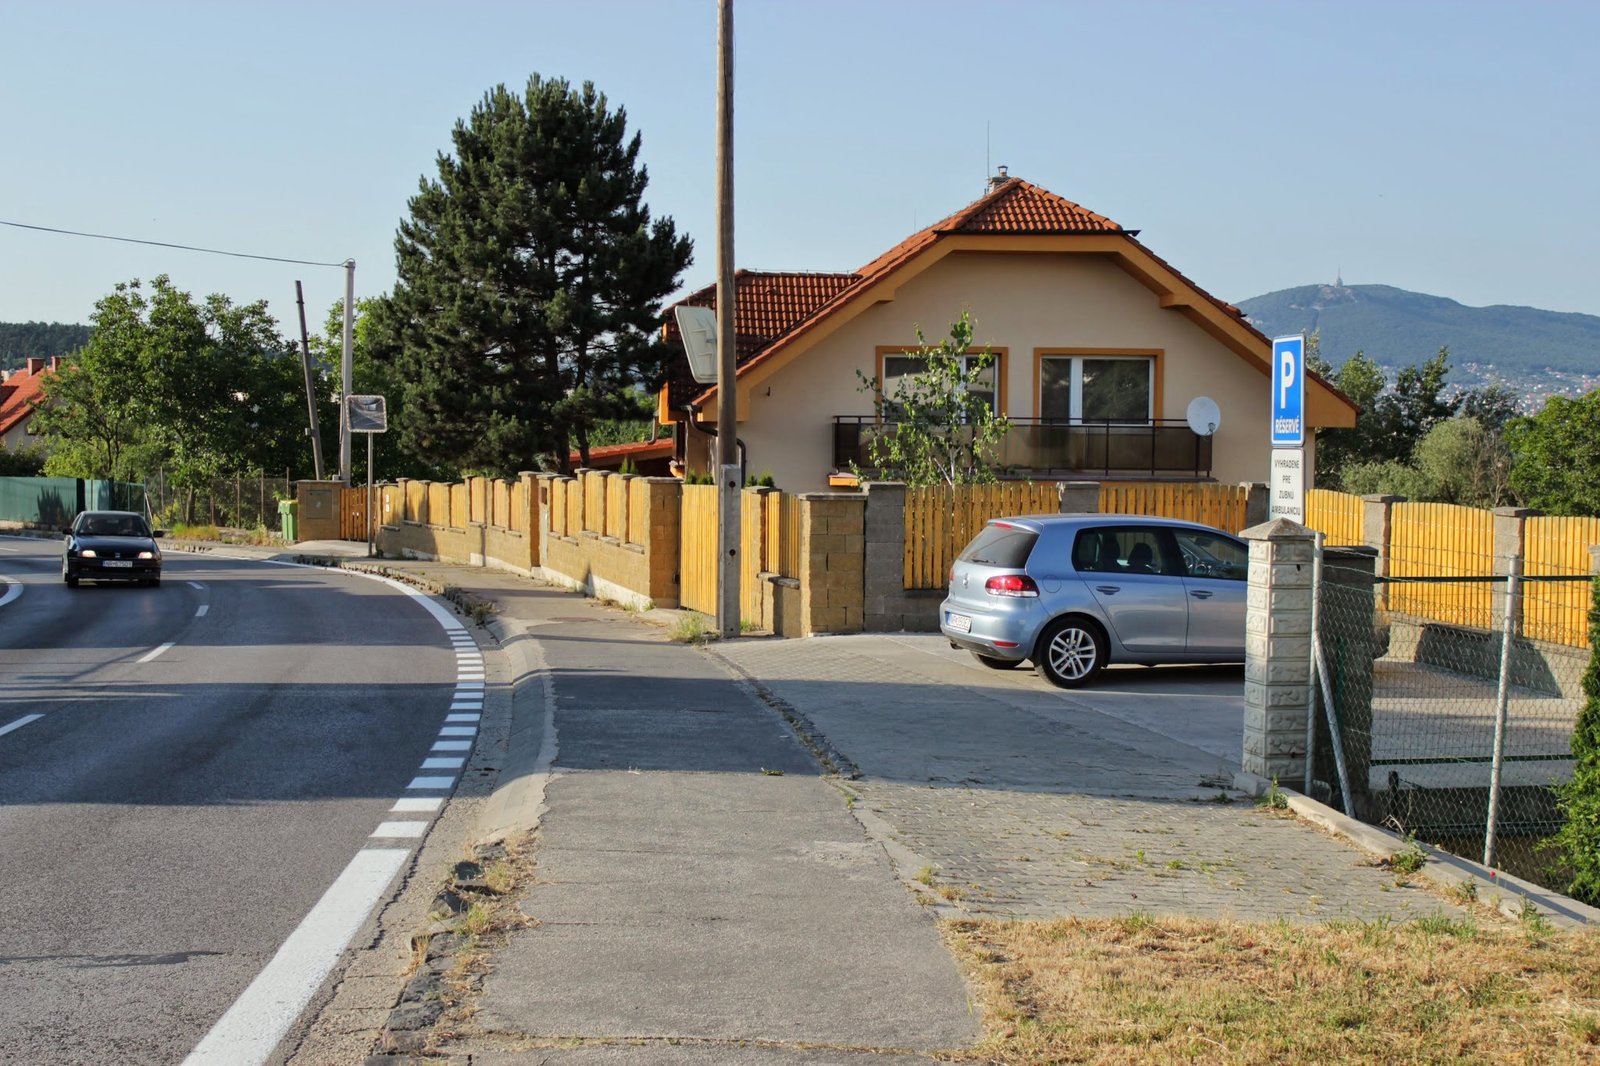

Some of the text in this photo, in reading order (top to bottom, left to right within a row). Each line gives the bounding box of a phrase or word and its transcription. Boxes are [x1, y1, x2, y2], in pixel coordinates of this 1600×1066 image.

[1280, 351, 1295, 409] P
[1275, 416, 1299, 434] RÉSERVÉ
[1282, 475, 1291, 484] PRE
